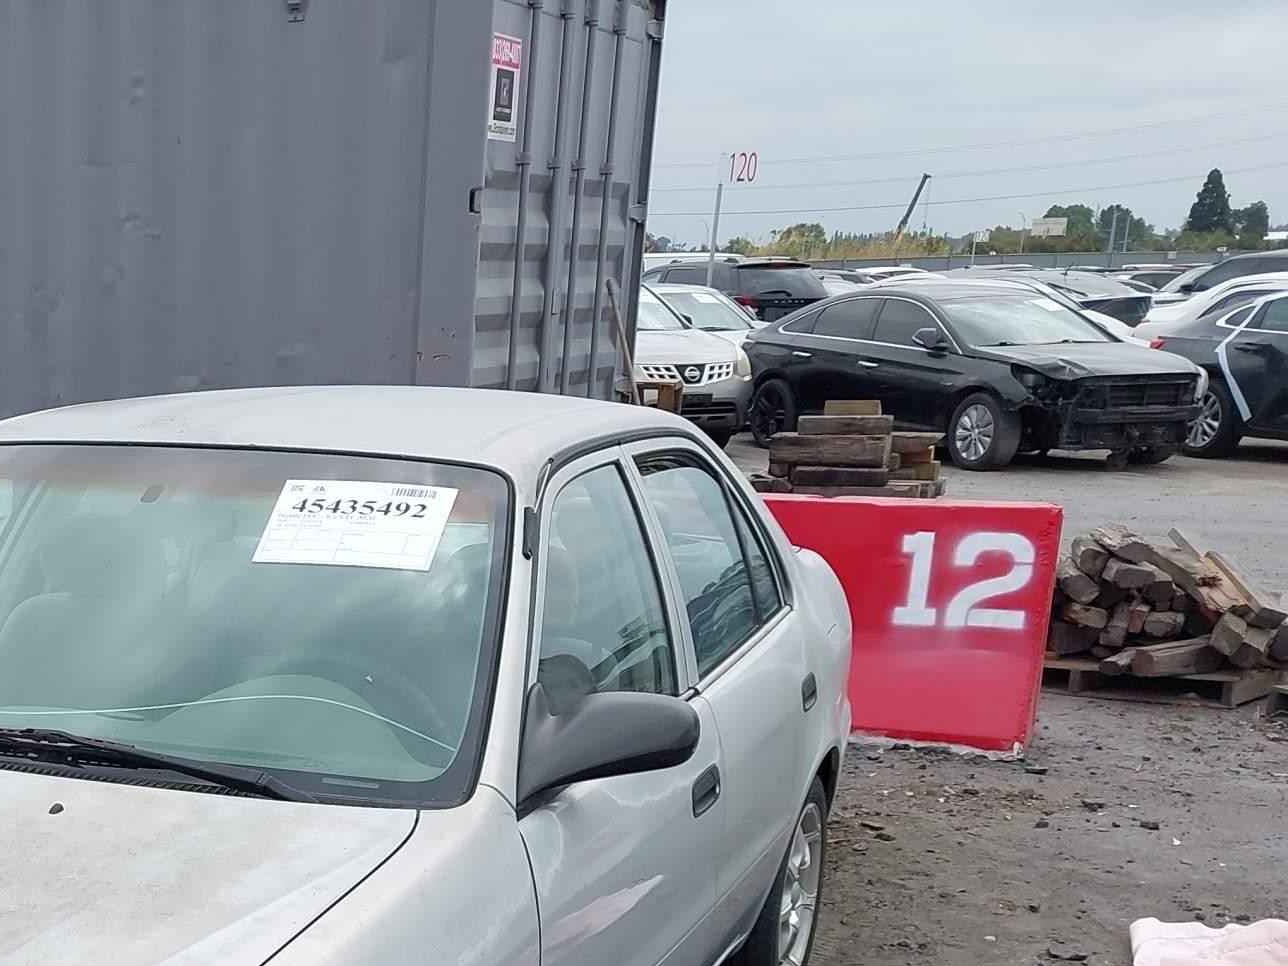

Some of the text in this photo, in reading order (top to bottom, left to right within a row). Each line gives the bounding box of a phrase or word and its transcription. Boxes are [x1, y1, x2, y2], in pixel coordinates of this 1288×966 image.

[730, 152, 757, 182] 120
[292, 498, 428, 518] 45435492
[891, 531, 1036, 630] 12
